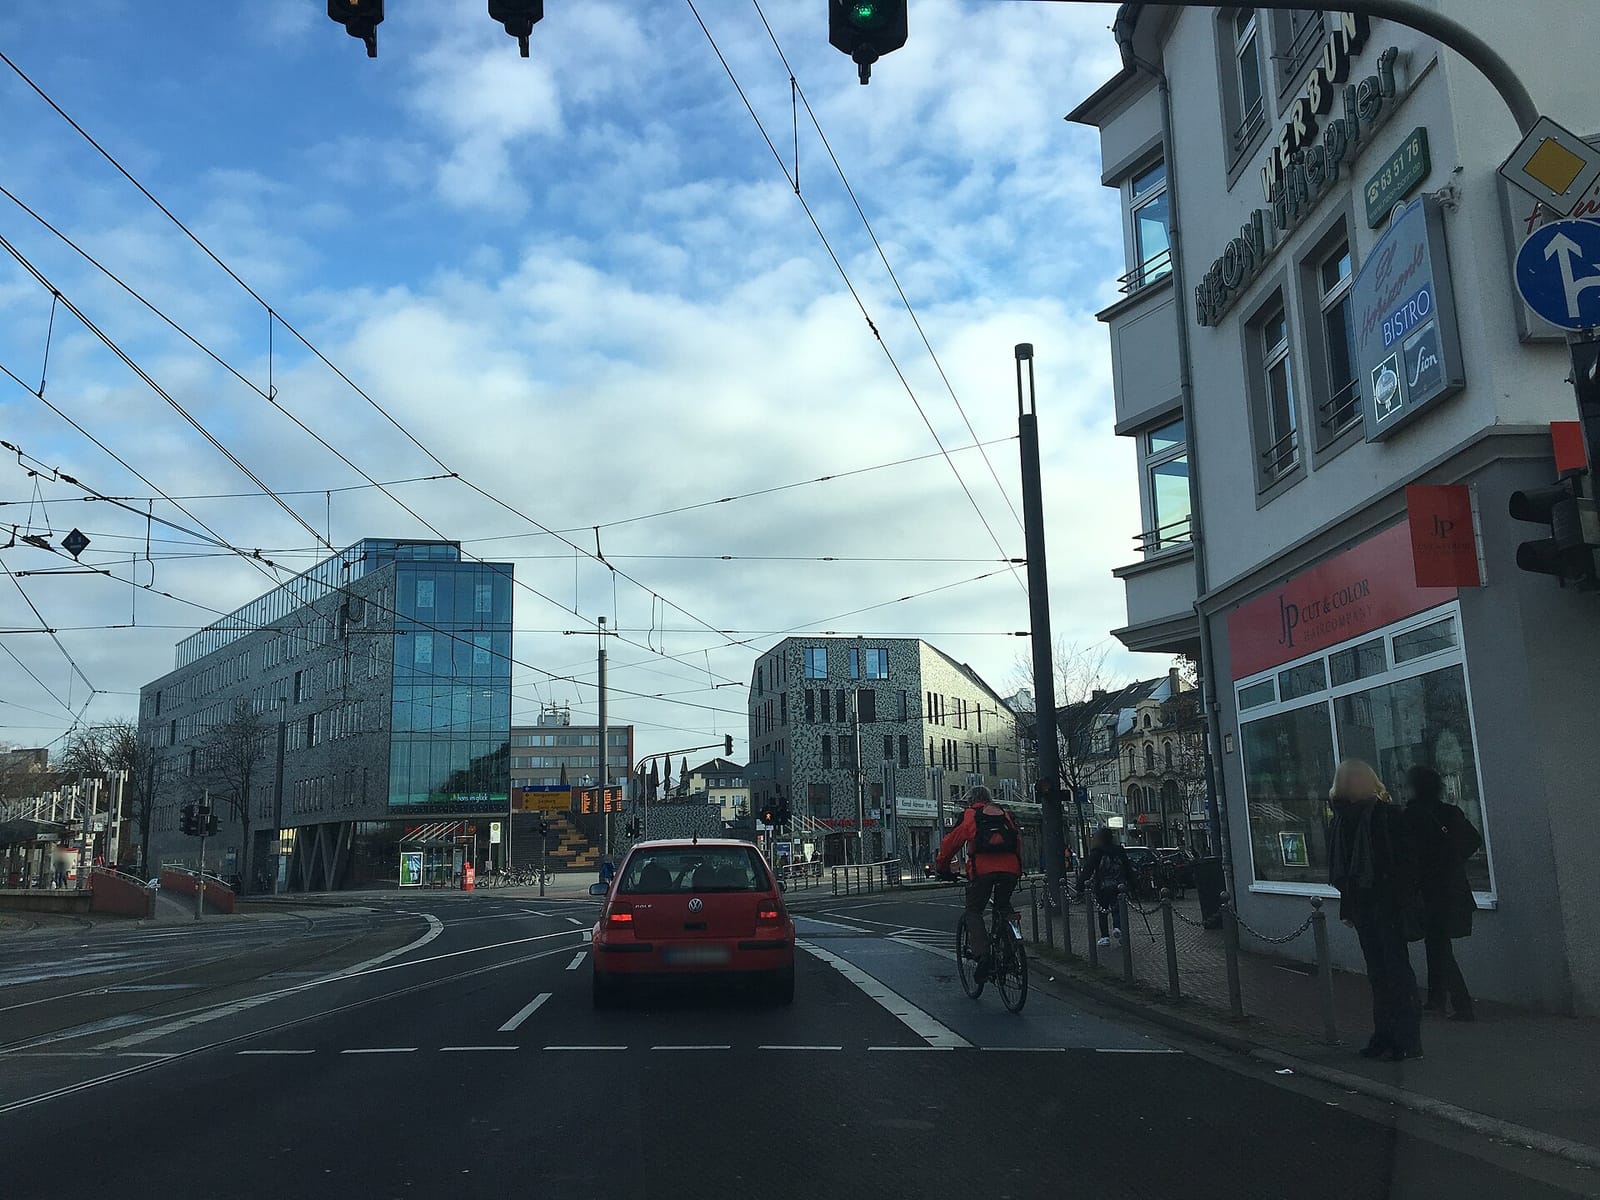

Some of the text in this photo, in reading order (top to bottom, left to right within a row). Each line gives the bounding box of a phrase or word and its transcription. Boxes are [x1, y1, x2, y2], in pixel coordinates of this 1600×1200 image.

[1195, 47, 1398, 326] NEON Hiepler
[1380, 138, 1419, 190] 63 51 76
[1383, 290, 1430, 347] BISTRO
[1409, 346, 1438, 387] Sion
[1301, 600, 1321, 623] CUT
[1332, 579, 1370, 609] COLOR
